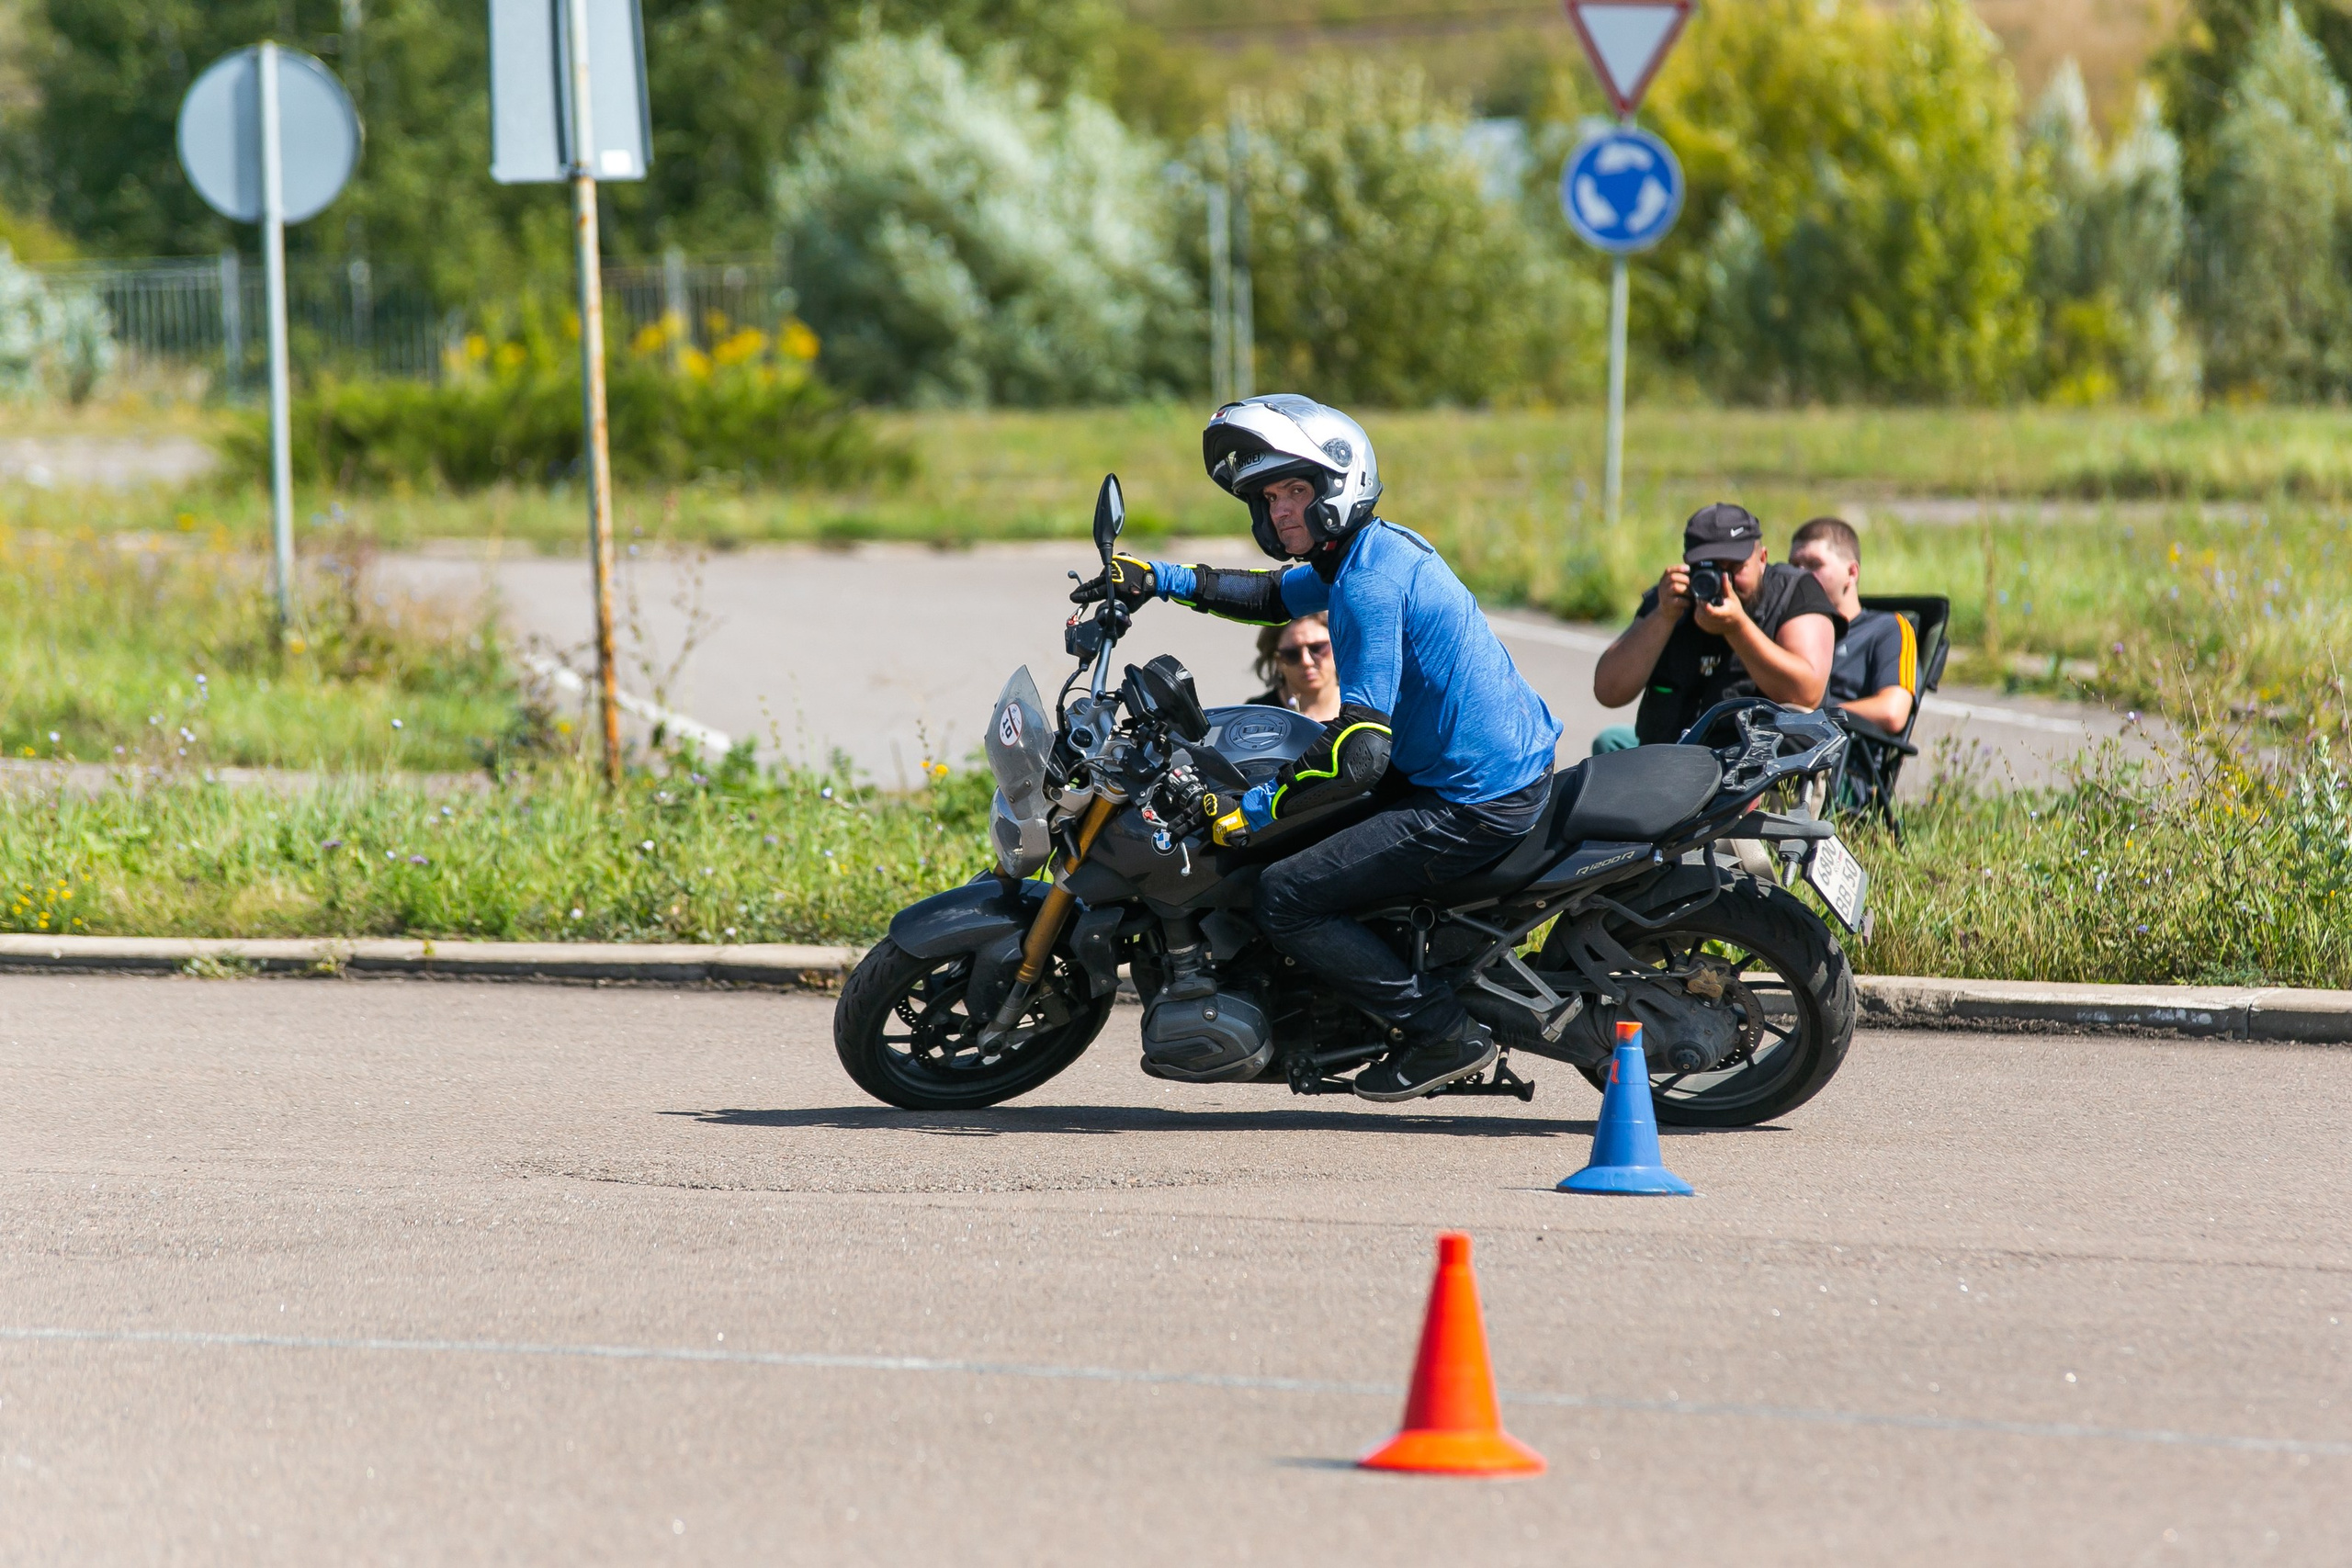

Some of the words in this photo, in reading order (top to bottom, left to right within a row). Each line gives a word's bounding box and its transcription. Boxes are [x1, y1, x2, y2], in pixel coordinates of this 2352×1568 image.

[1238, 452, 1261, 469] SHOEI
[1817, 840, 1837, 886] 6800
[1843, 858, 1858, 888] 50
